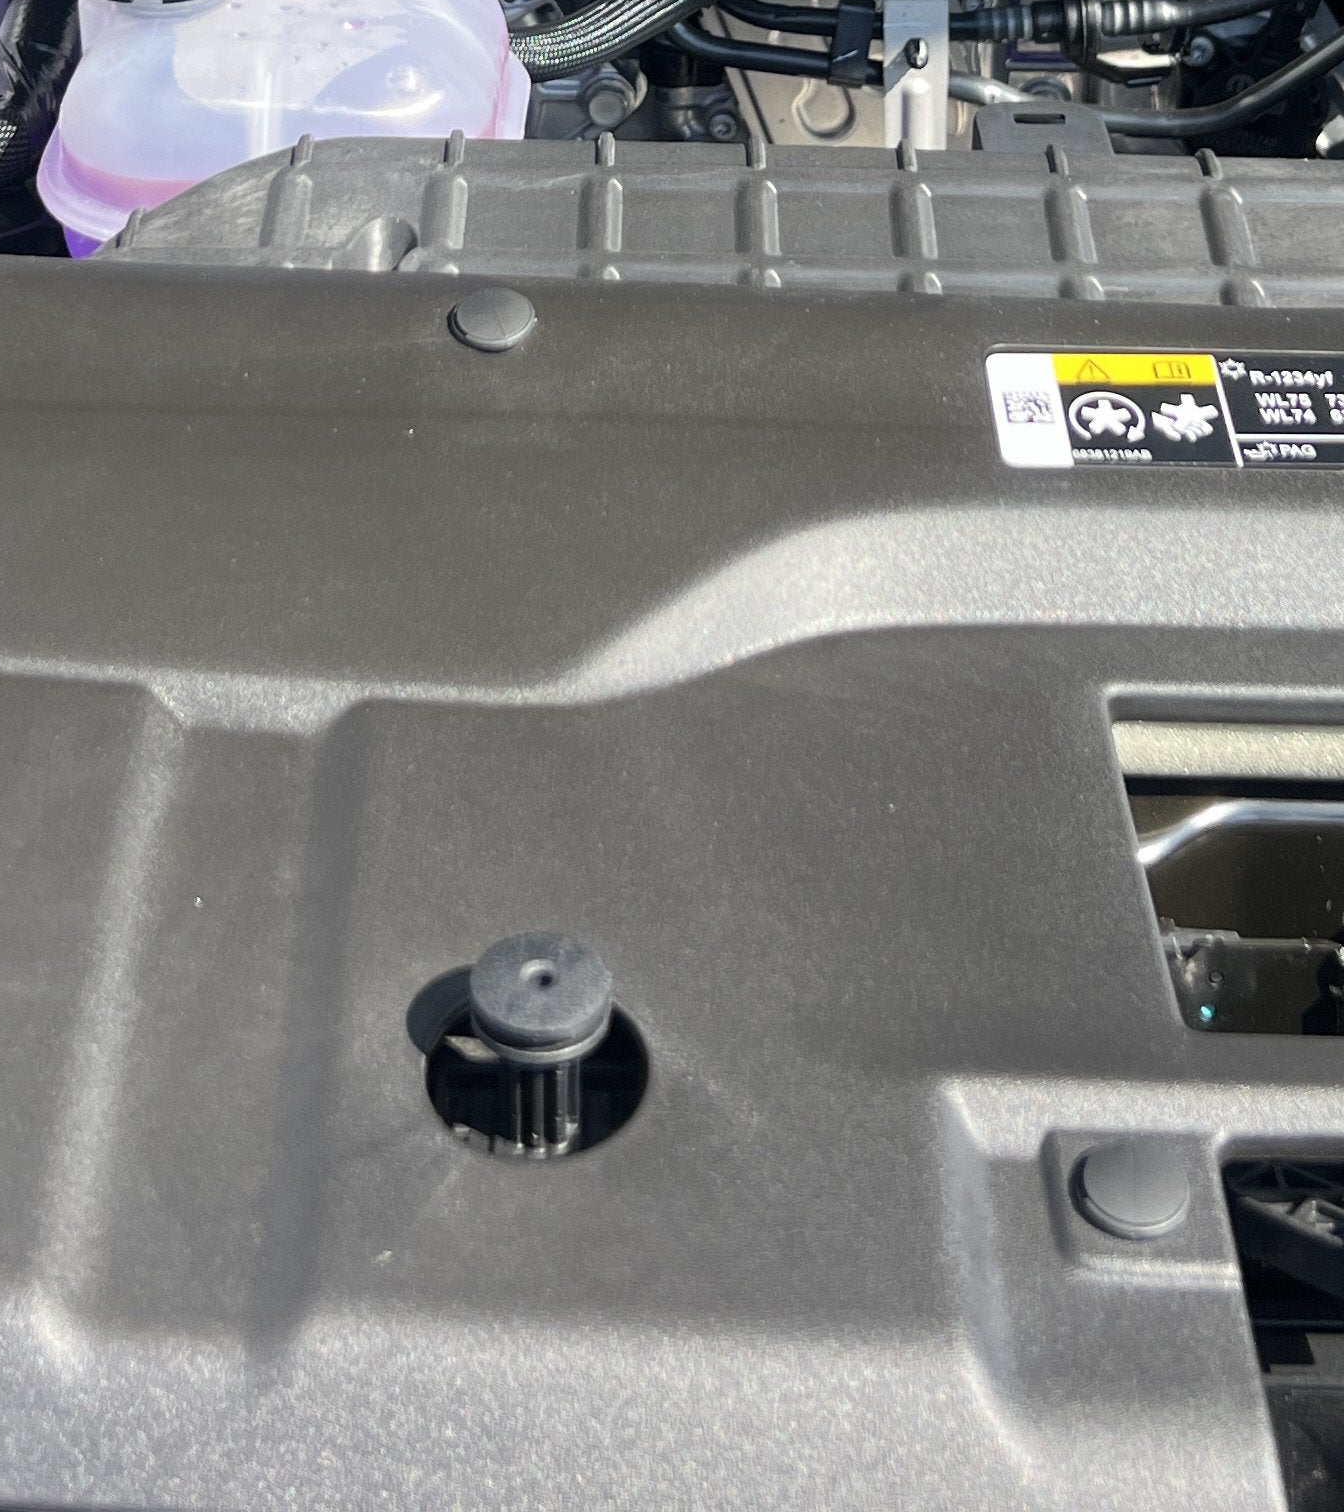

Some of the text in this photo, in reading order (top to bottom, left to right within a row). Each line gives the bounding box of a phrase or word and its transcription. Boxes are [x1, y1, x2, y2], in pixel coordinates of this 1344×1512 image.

[1249, 370, 1334, 389] R-1234yf
[1254, 392, 1312, 409] WL75
[1259, 408, 1317, 425] WL74
[1279, 444, 1317, 460] PAG
